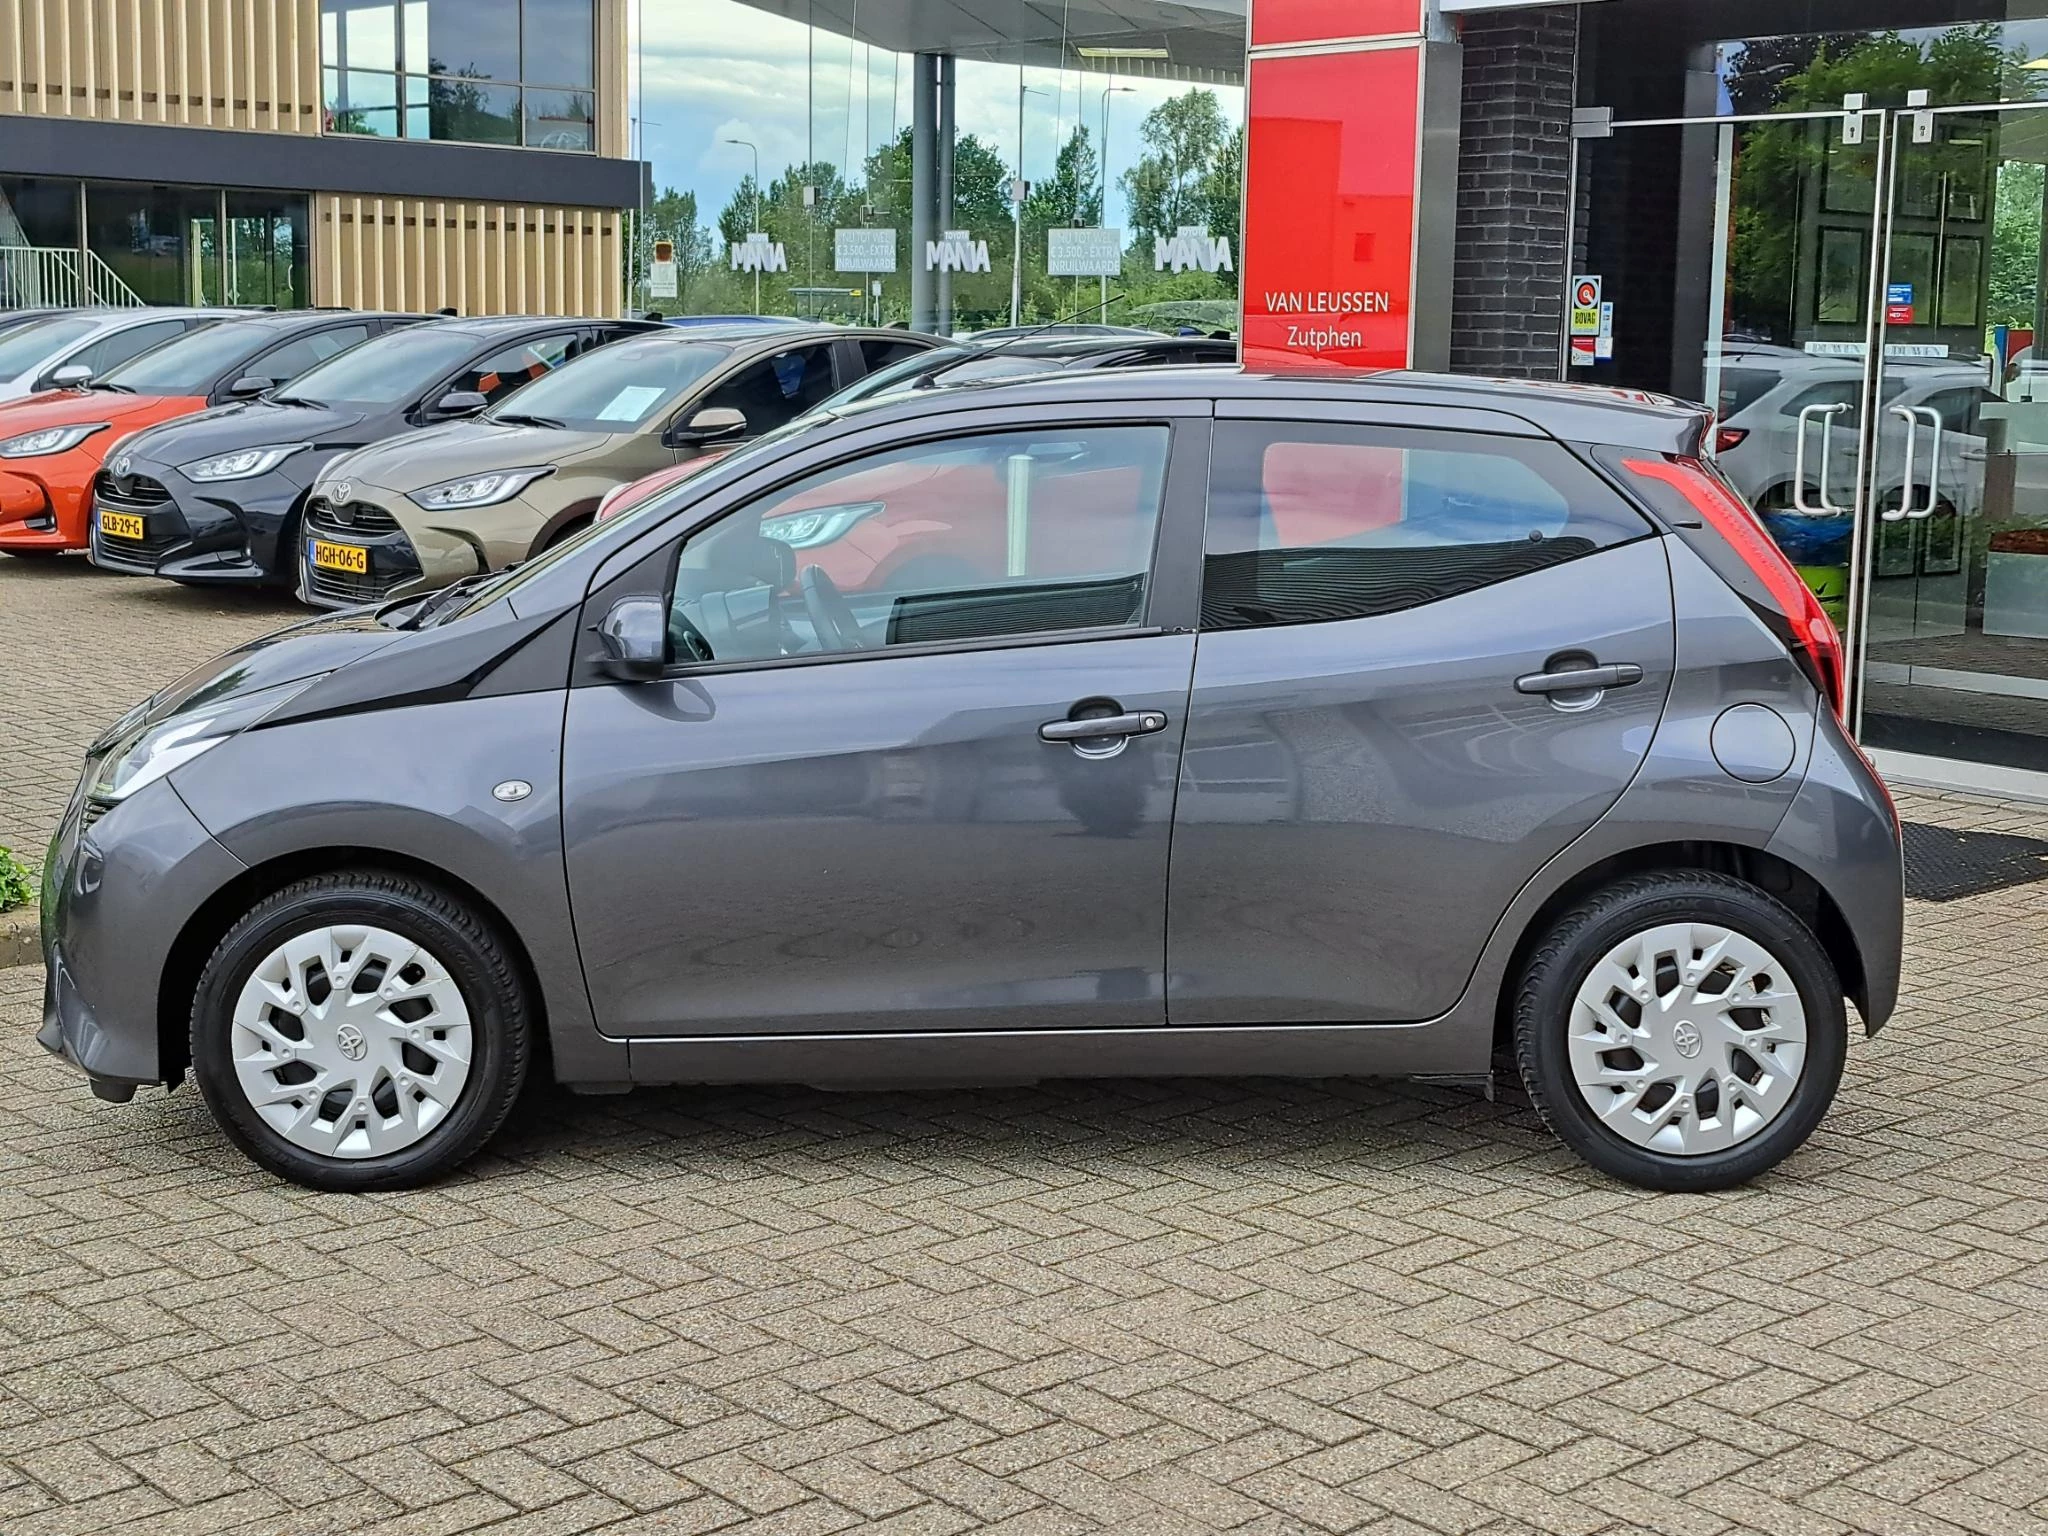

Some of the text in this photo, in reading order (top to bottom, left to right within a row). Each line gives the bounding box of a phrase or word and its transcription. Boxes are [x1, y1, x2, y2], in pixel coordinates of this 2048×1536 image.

[926, 240, 991, 273] MANIA
[1090, 246, 1120, 258] EXTRA
[1265, 292, 1389, 312] VAN LEUSSEN
[1575, 312, 1596, 325] BOVAG
[1287, 326, 1361, 352] Zutphen
[102, 515, 140, 535] GLB-29-G
[315, 544, 364, 569] HGH-06-G
